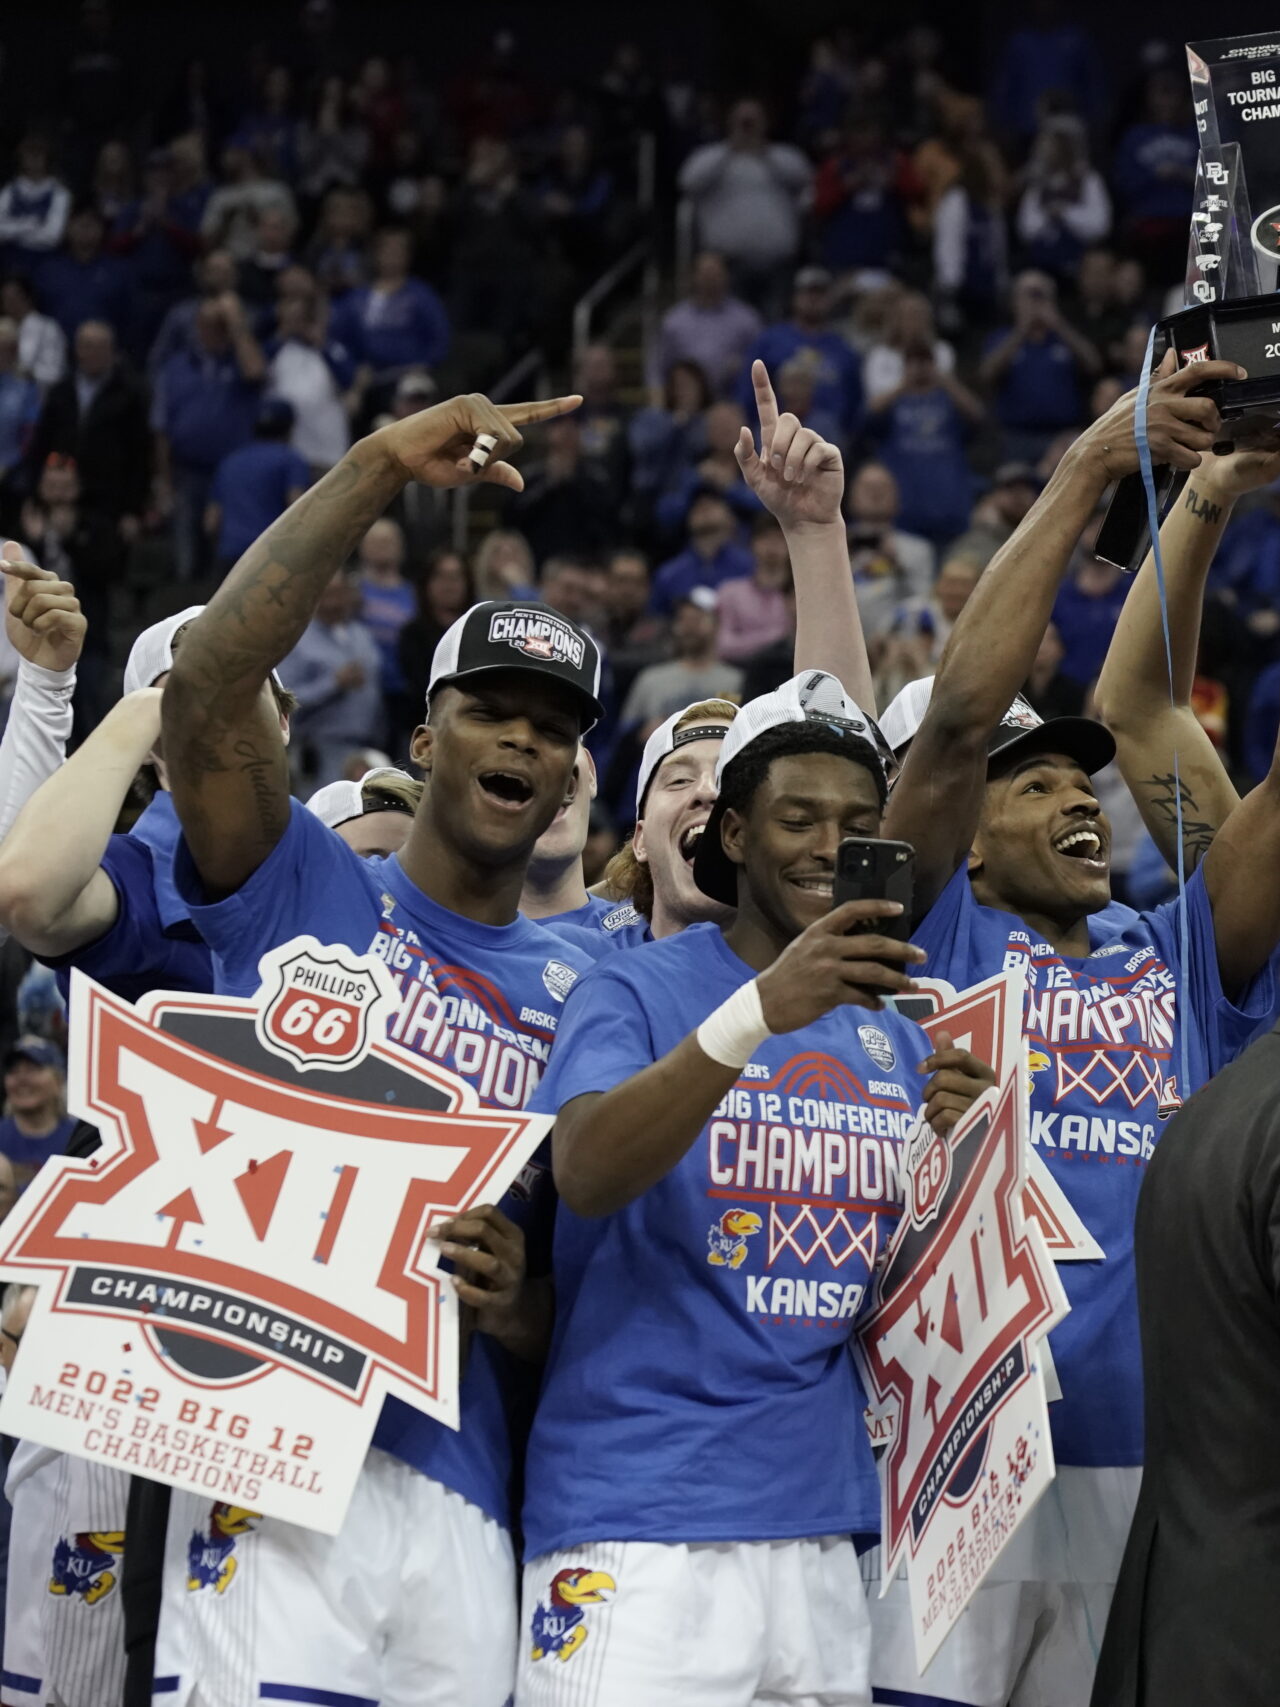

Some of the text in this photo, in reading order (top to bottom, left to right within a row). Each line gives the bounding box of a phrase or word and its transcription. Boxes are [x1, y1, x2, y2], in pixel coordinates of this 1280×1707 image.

[1251, 70, 1276, 85] BIG
[1187, 488, 1221, 524] PLAN
[492, 618, 581, 664] CHAMPIONS
[366, 931, 413, 970] BIG
[1031, 943, 1055, 957] MEN
[292, 966, 368, 1003] PHILLIPS
[1046, 966, 1072, 988] 12
[281, 999, 352, 1045] 66
[519, 1007, 558, 1031] BASKE
[868, 1080, 909, 1100] BASKET
[711, 1090, 917, 1141] BIG 12 CONFERENC
[1030, 1110, 1156, 1160] KANSA
[709, 1121, 905, 1202] CHAMPION
[911, 1131, 937, 1166] PHILLI
[918, 1148, 941, 1207] 66
[746, 1275, 867, 1319] KANSA
[91, 1276, 345, 1365] CHAMPIONSHIP
[58, 1362, 315, 1460] 2022 BIG 12
[28, 1385, 324, 1495] MEN'S BASKETBALL
[83, 1429, 263, 1501] CHAMPIONS
[922, 1460, 1035, 1636] MEN'S BASKETB
[928, 1527, 965, 1598] 2022
[972, 1469, 999, 1528] BIG
[66, 1557, 92, 1576] KU
[202, 1548, 221, 1568] KU
[948, 1505, 1017, 1621] CHAMPIONS
[543, 1616, 566, 1638] KU
